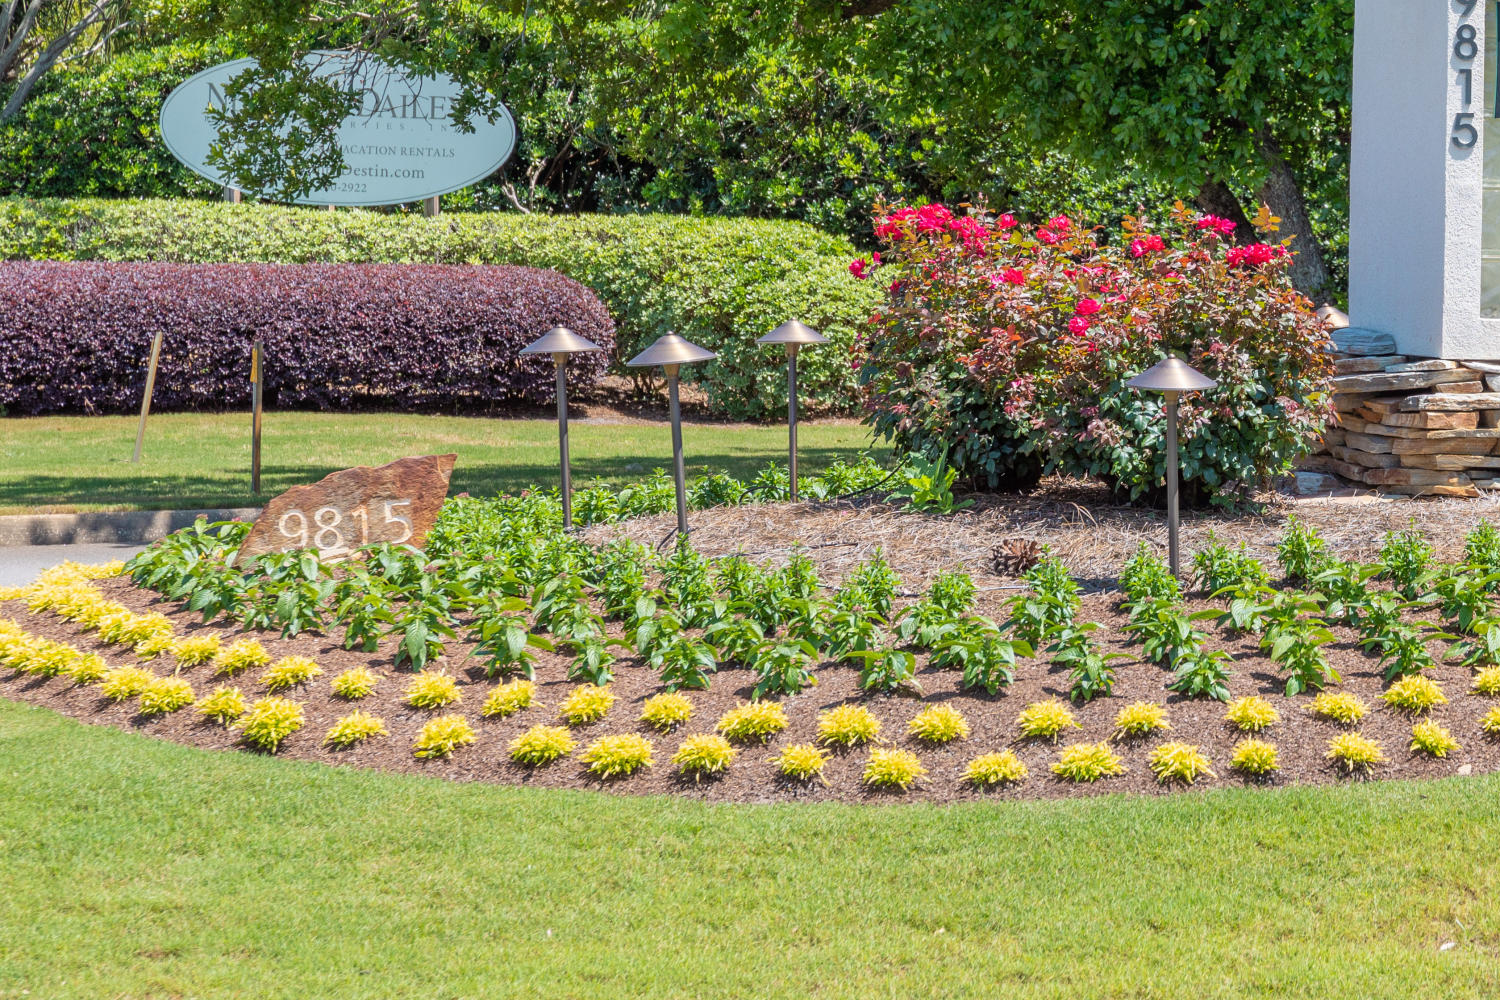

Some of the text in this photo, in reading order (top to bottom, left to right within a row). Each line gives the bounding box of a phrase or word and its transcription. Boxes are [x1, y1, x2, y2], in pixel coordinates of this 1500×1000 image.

[357, 87, 454, 120] DAILE
[342, 144, 397, 156] ACATION
[400, 147, 455, 158] RENTALS
[278, 499, 414, 551] 9815
